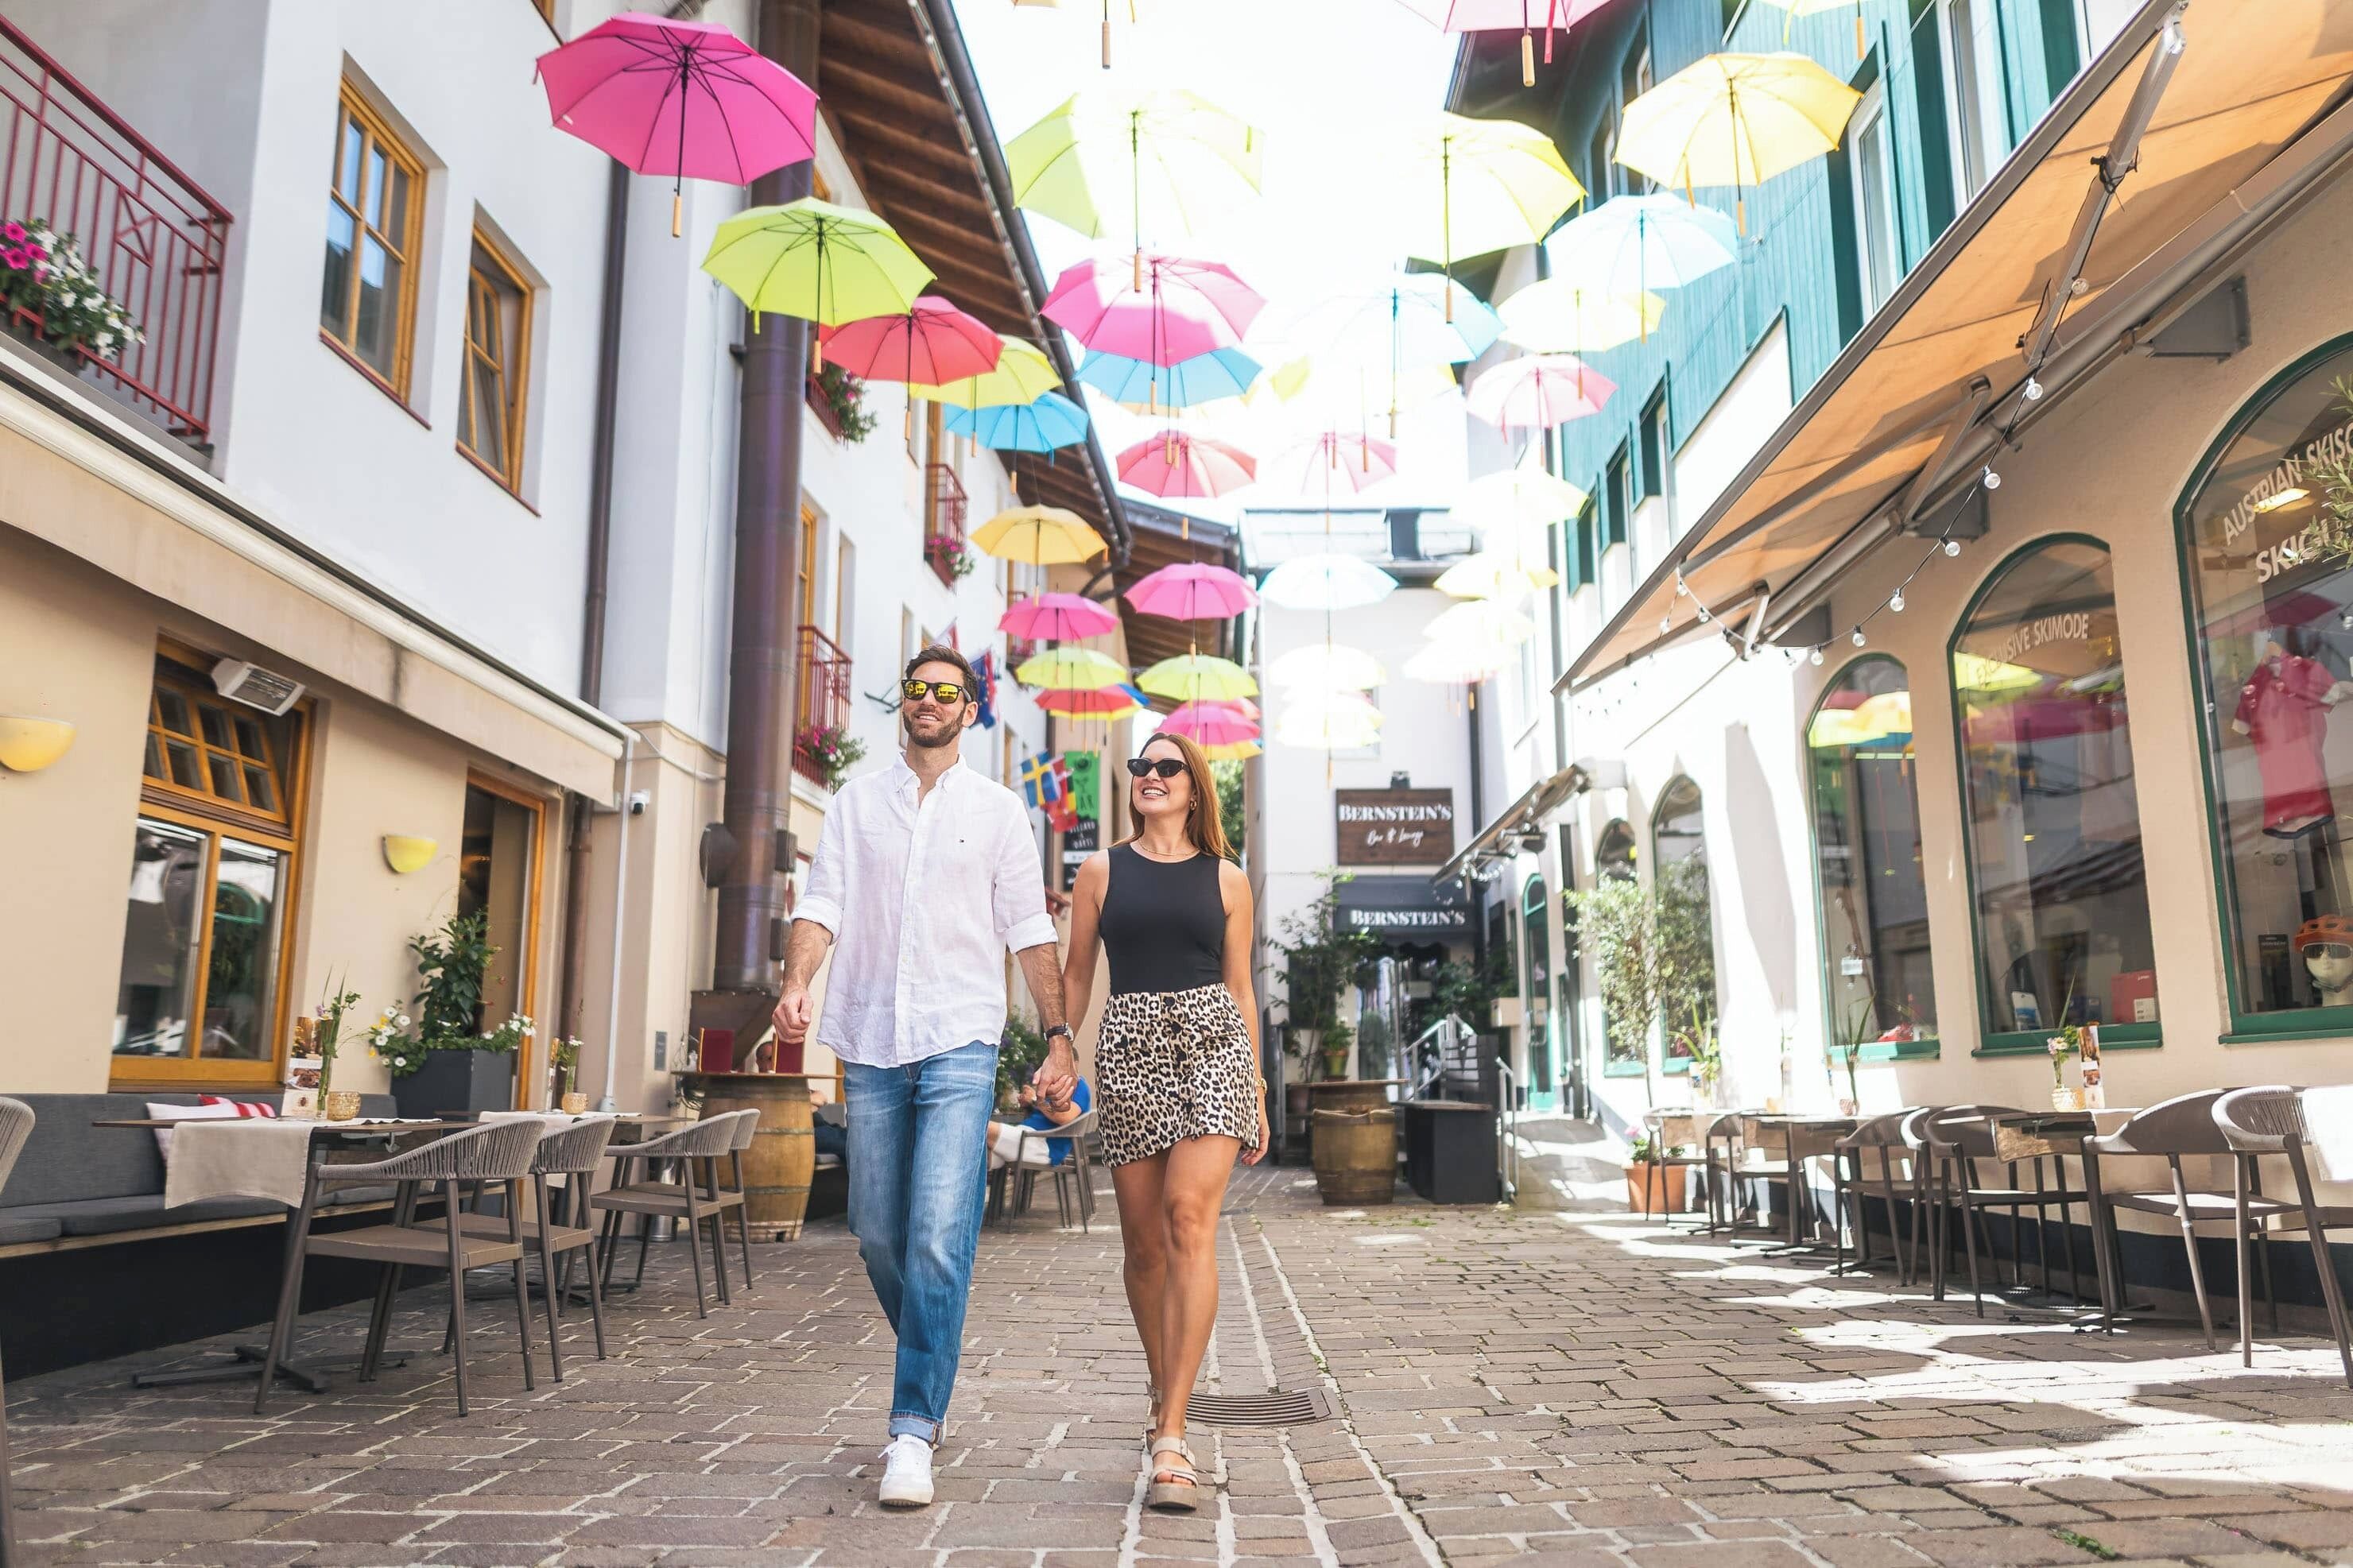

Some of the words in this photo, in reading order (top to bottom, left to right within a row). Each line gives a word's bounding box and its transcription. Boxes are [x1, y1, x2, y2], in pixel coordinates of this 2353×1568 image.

[2223, 454, 2303, 546] AUSTRIAN
[2033, 613, 2089, 646] SKIMODE
[1339, 803, 1452, 821] BERNSTEIN'S
[1351, 909, 1465, 927] BERNSTEIN'S
